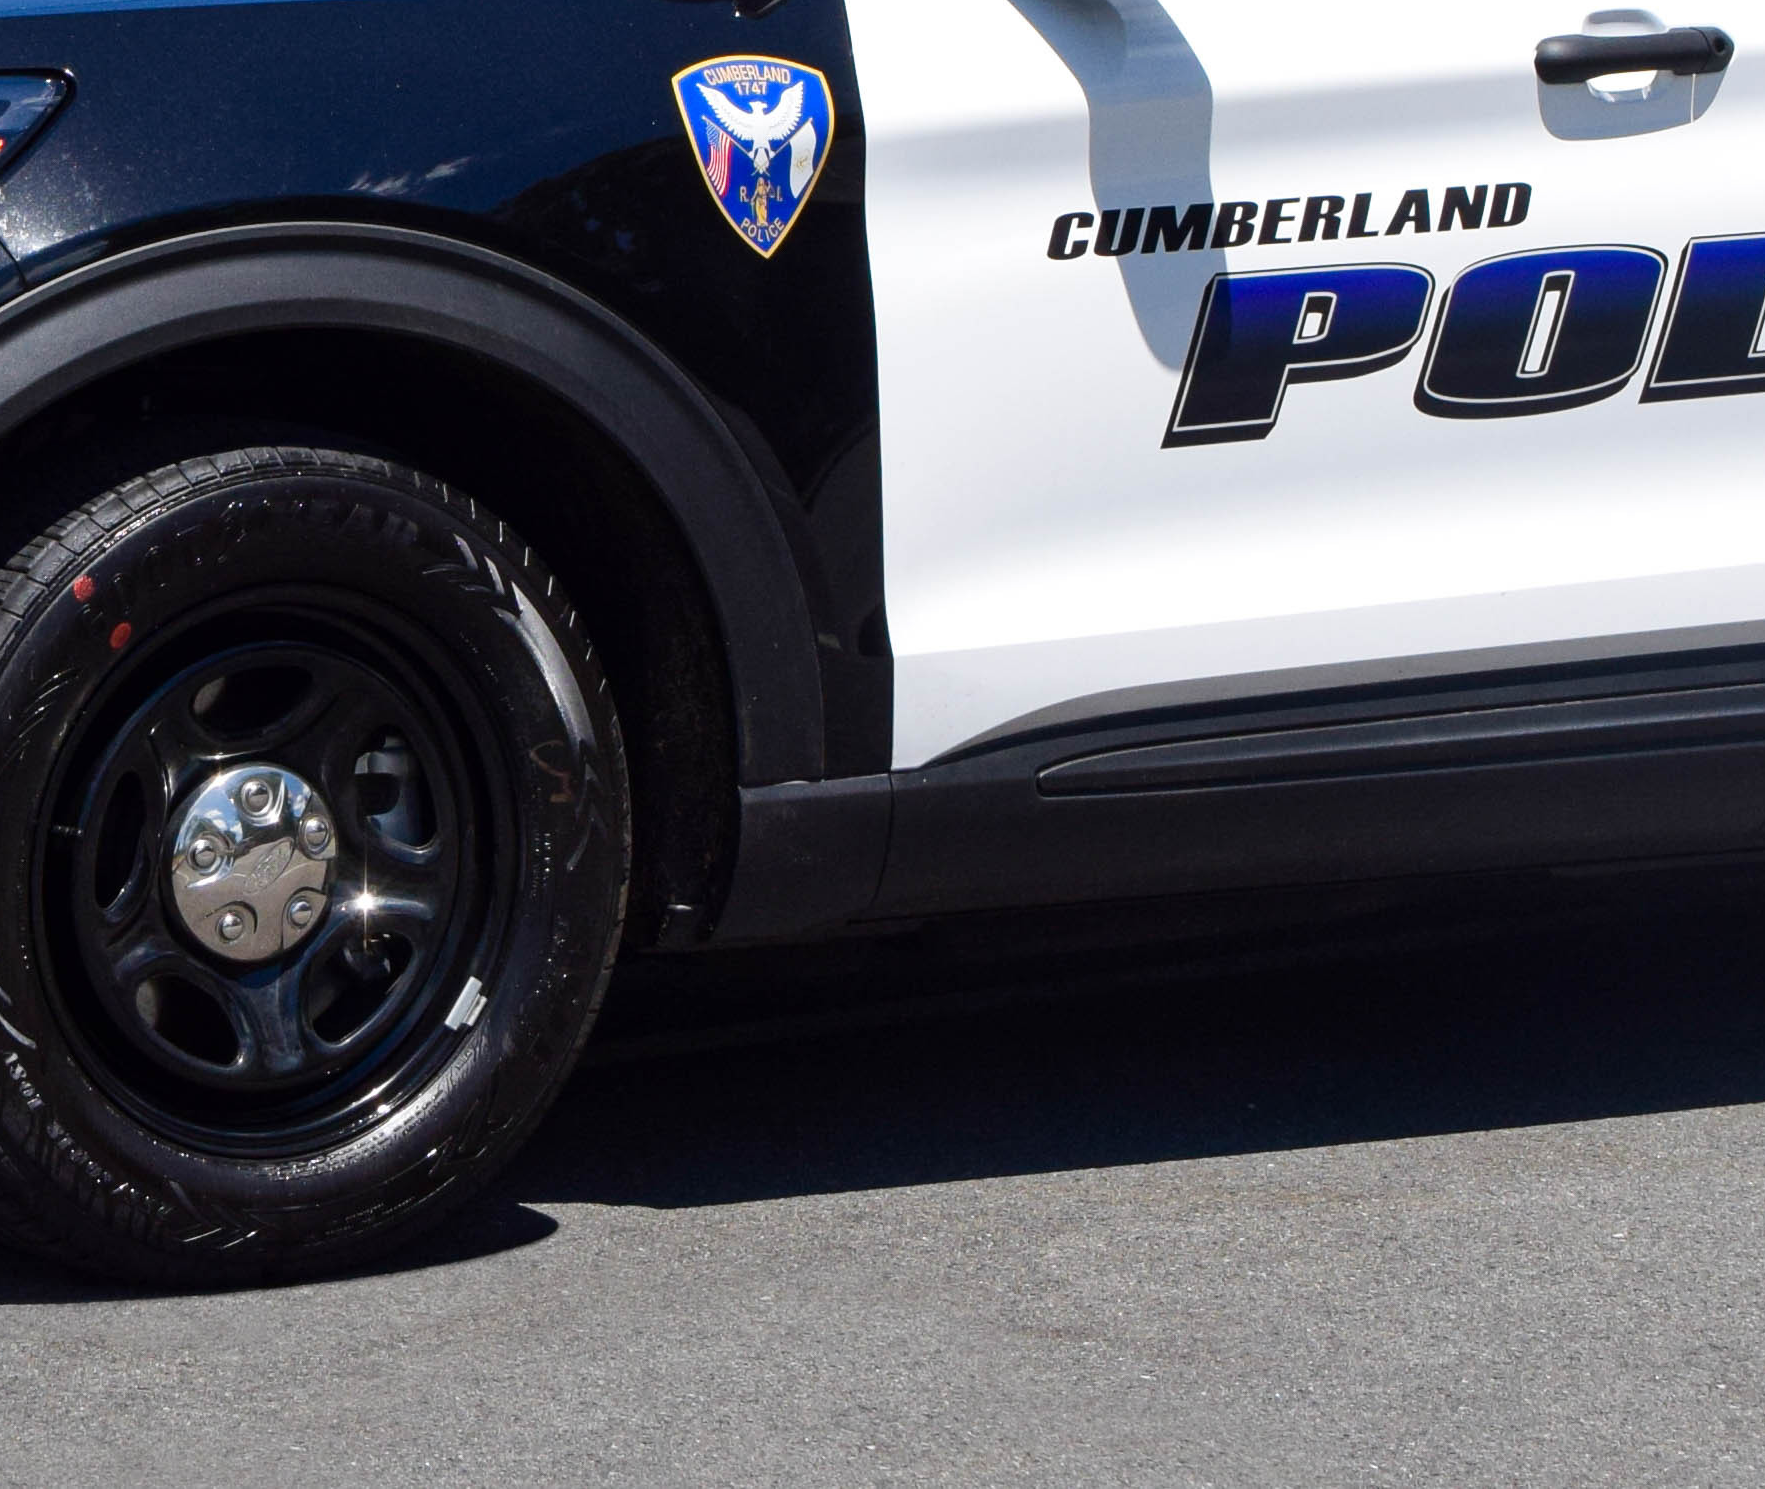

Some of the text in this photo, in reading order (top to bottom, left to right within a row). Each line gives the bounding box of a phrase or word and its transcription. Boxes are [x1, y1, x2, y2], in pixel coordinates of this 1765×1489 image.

[703, 64, 791, 86] CUMBERLAND
[734, 81, 769, 96] 1747
[740, 217, 786, 243] POLICE
[1046, 182, 1532, 260] CUMBERLAND
